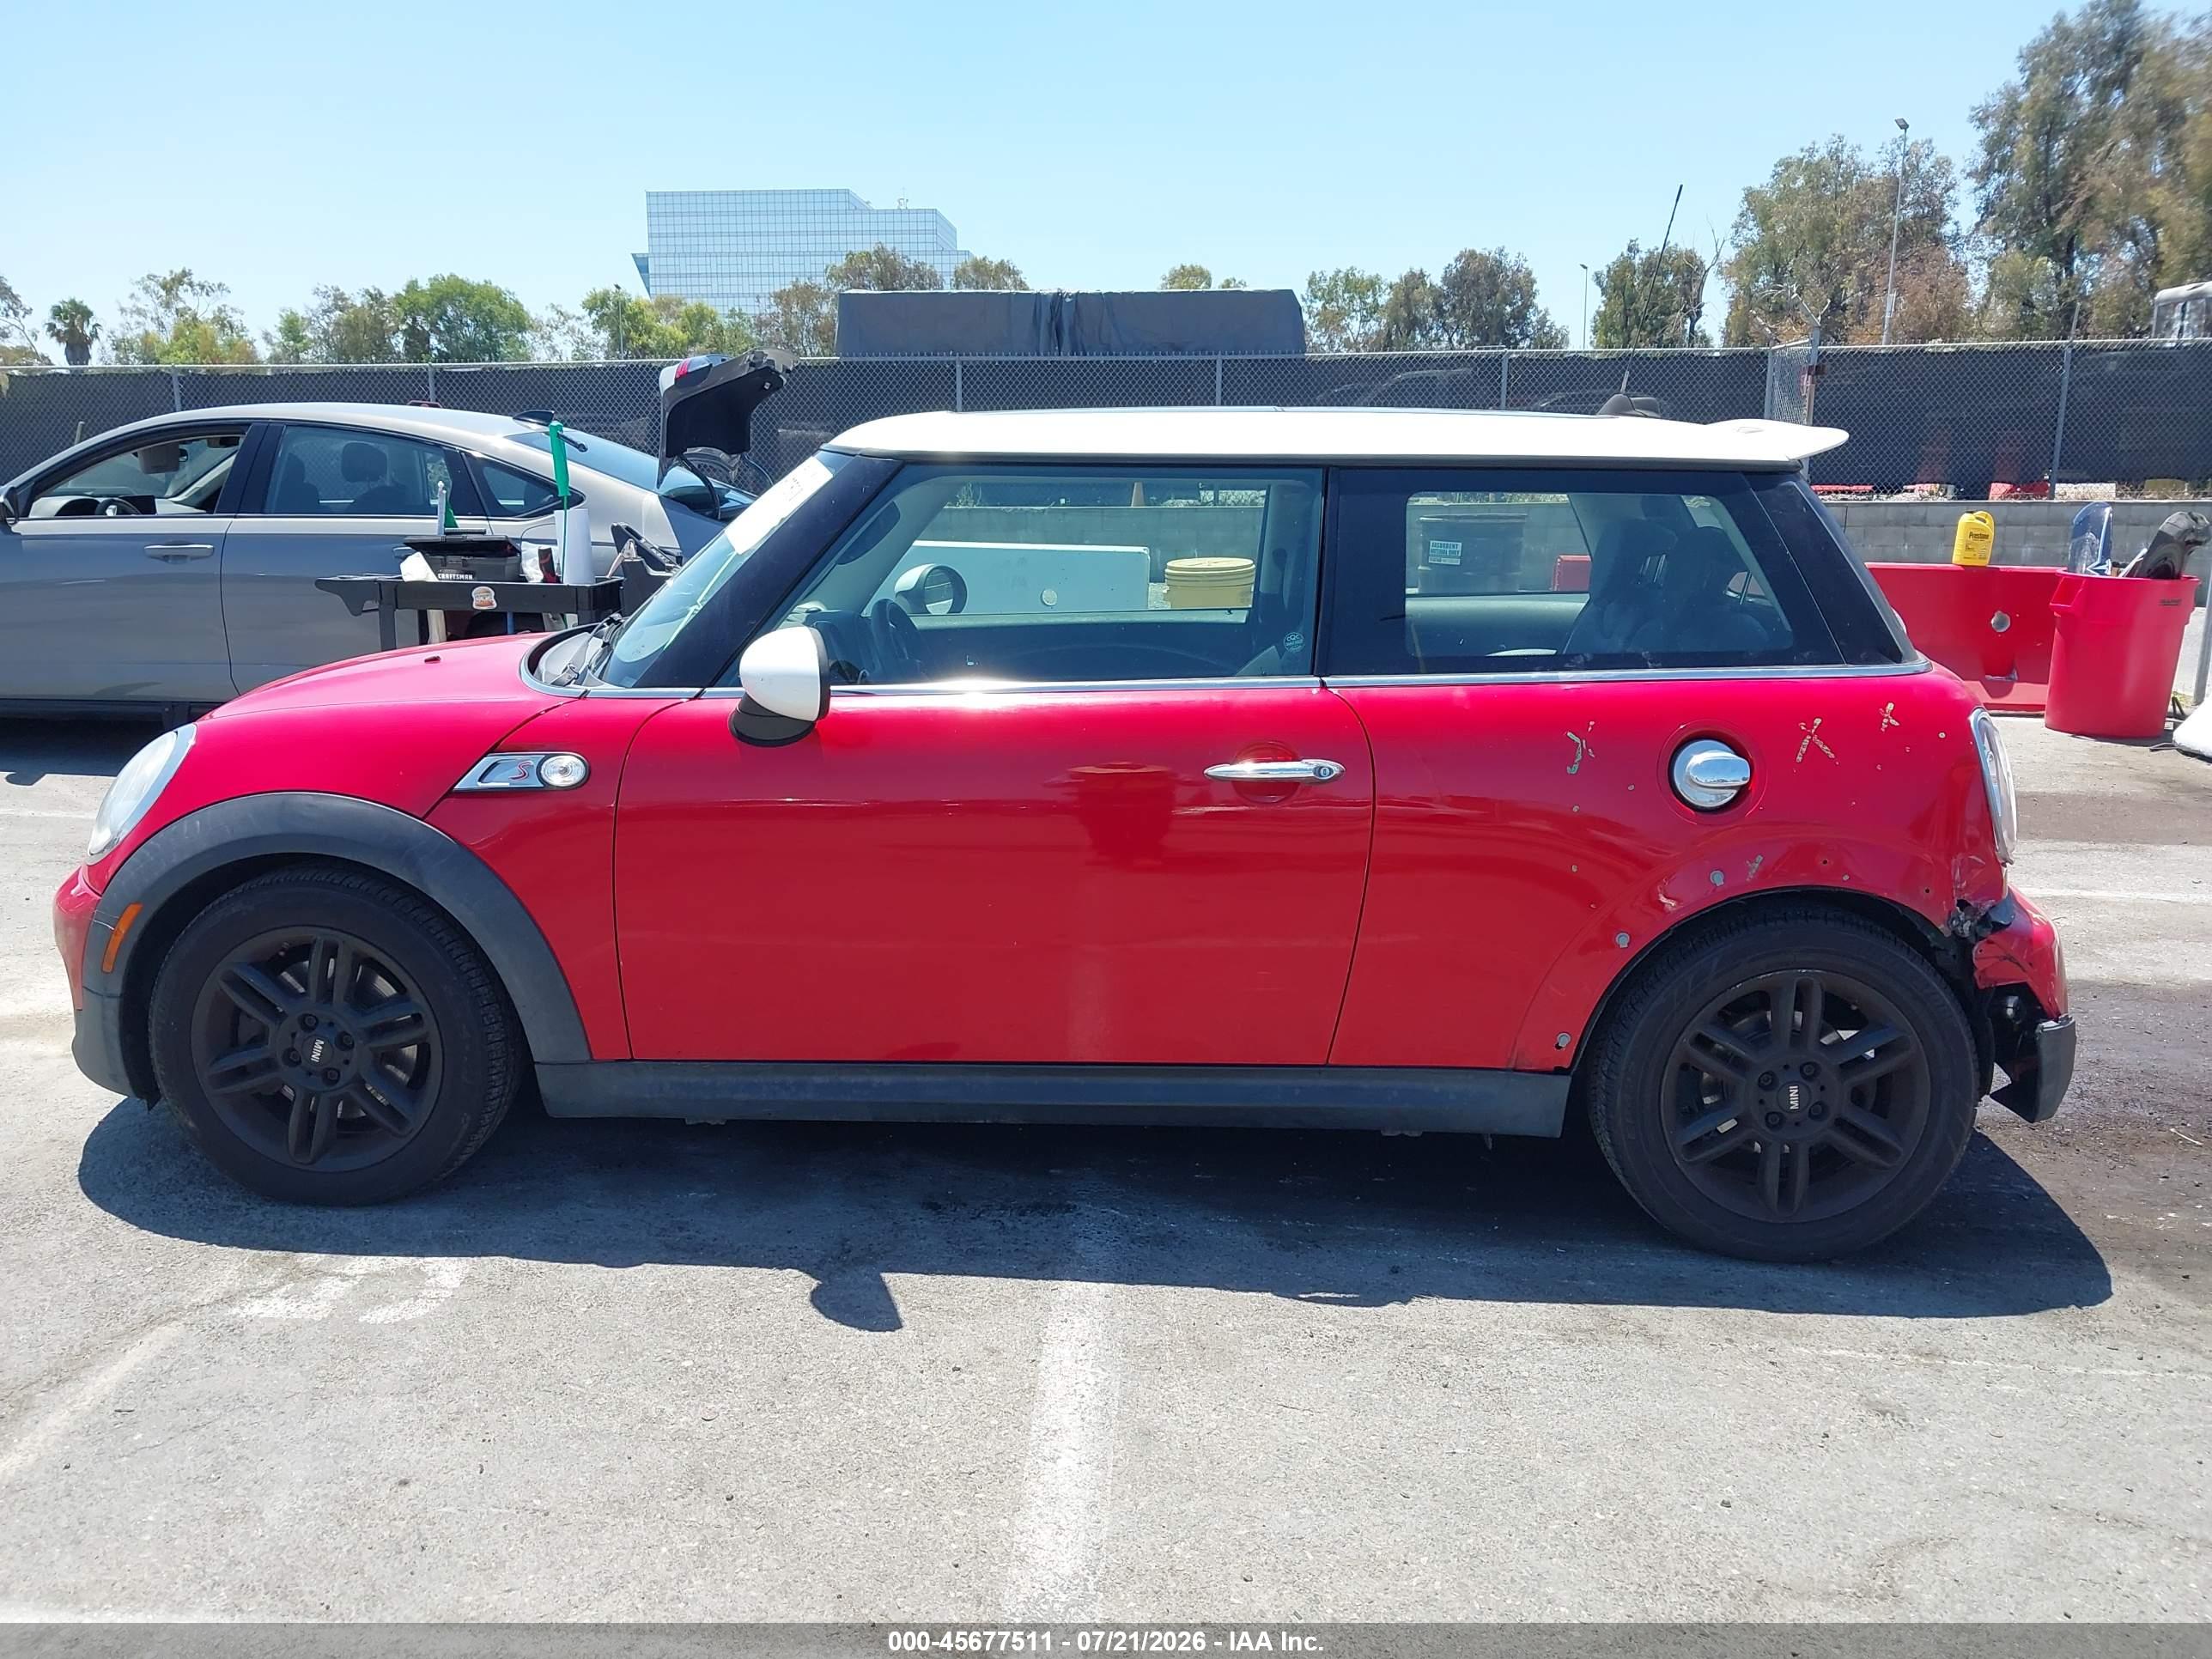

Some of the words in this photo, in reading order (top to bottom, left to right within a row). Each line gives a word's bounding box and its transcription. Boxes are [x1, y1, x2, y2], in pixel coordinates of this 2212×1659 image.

[1968, 531, 1990, 539] Prestone
[508, 760, 533, 781] S
[310, 1039, 325, 1063] MINI
[1789, 1085, 1800, 1109] MINI
